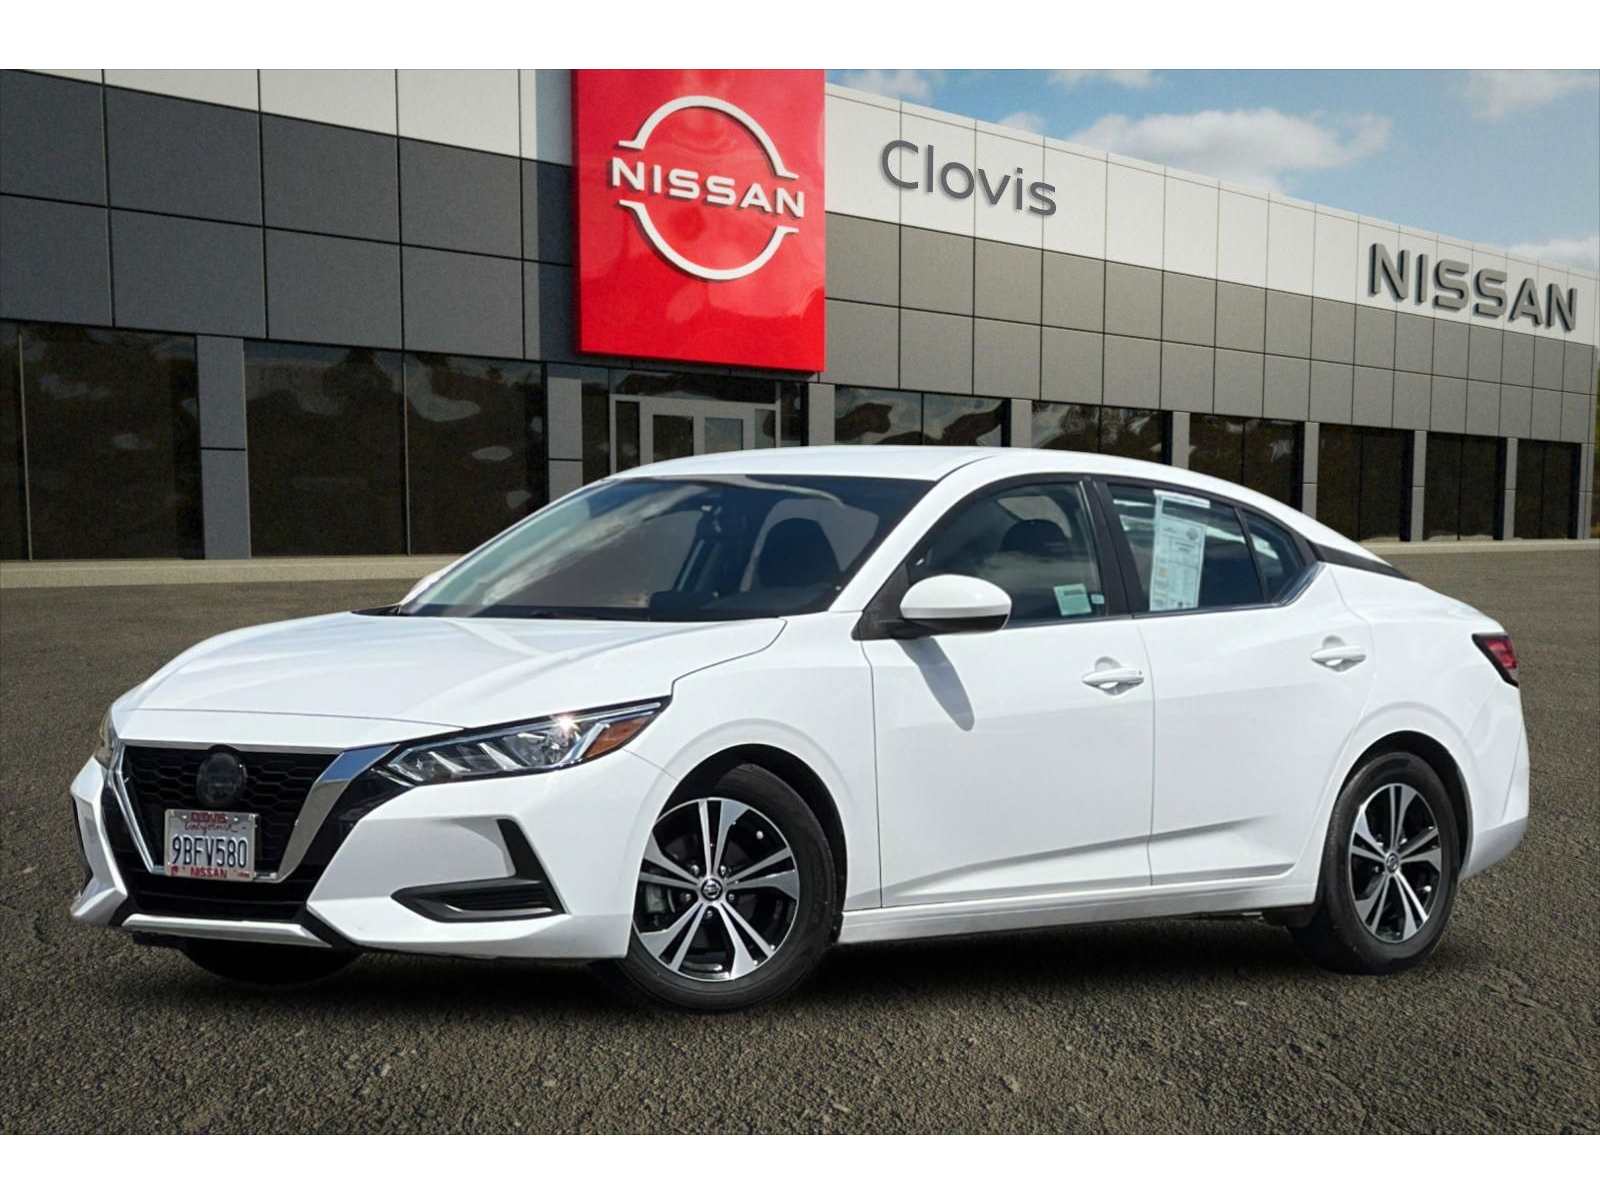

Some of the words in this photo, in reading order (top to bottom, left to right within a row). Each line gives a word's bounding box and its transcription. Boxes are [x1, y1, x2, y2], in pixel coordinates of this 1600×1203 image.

[610, 157, 805, 219] NISSAN
[881, 139, 1057, 216] Clovis
[1368, 243, 1578, 332] NISSAN
[172, 836, 248, 868] 9BFV580
[190, 866, 228, 878] NISSAN
